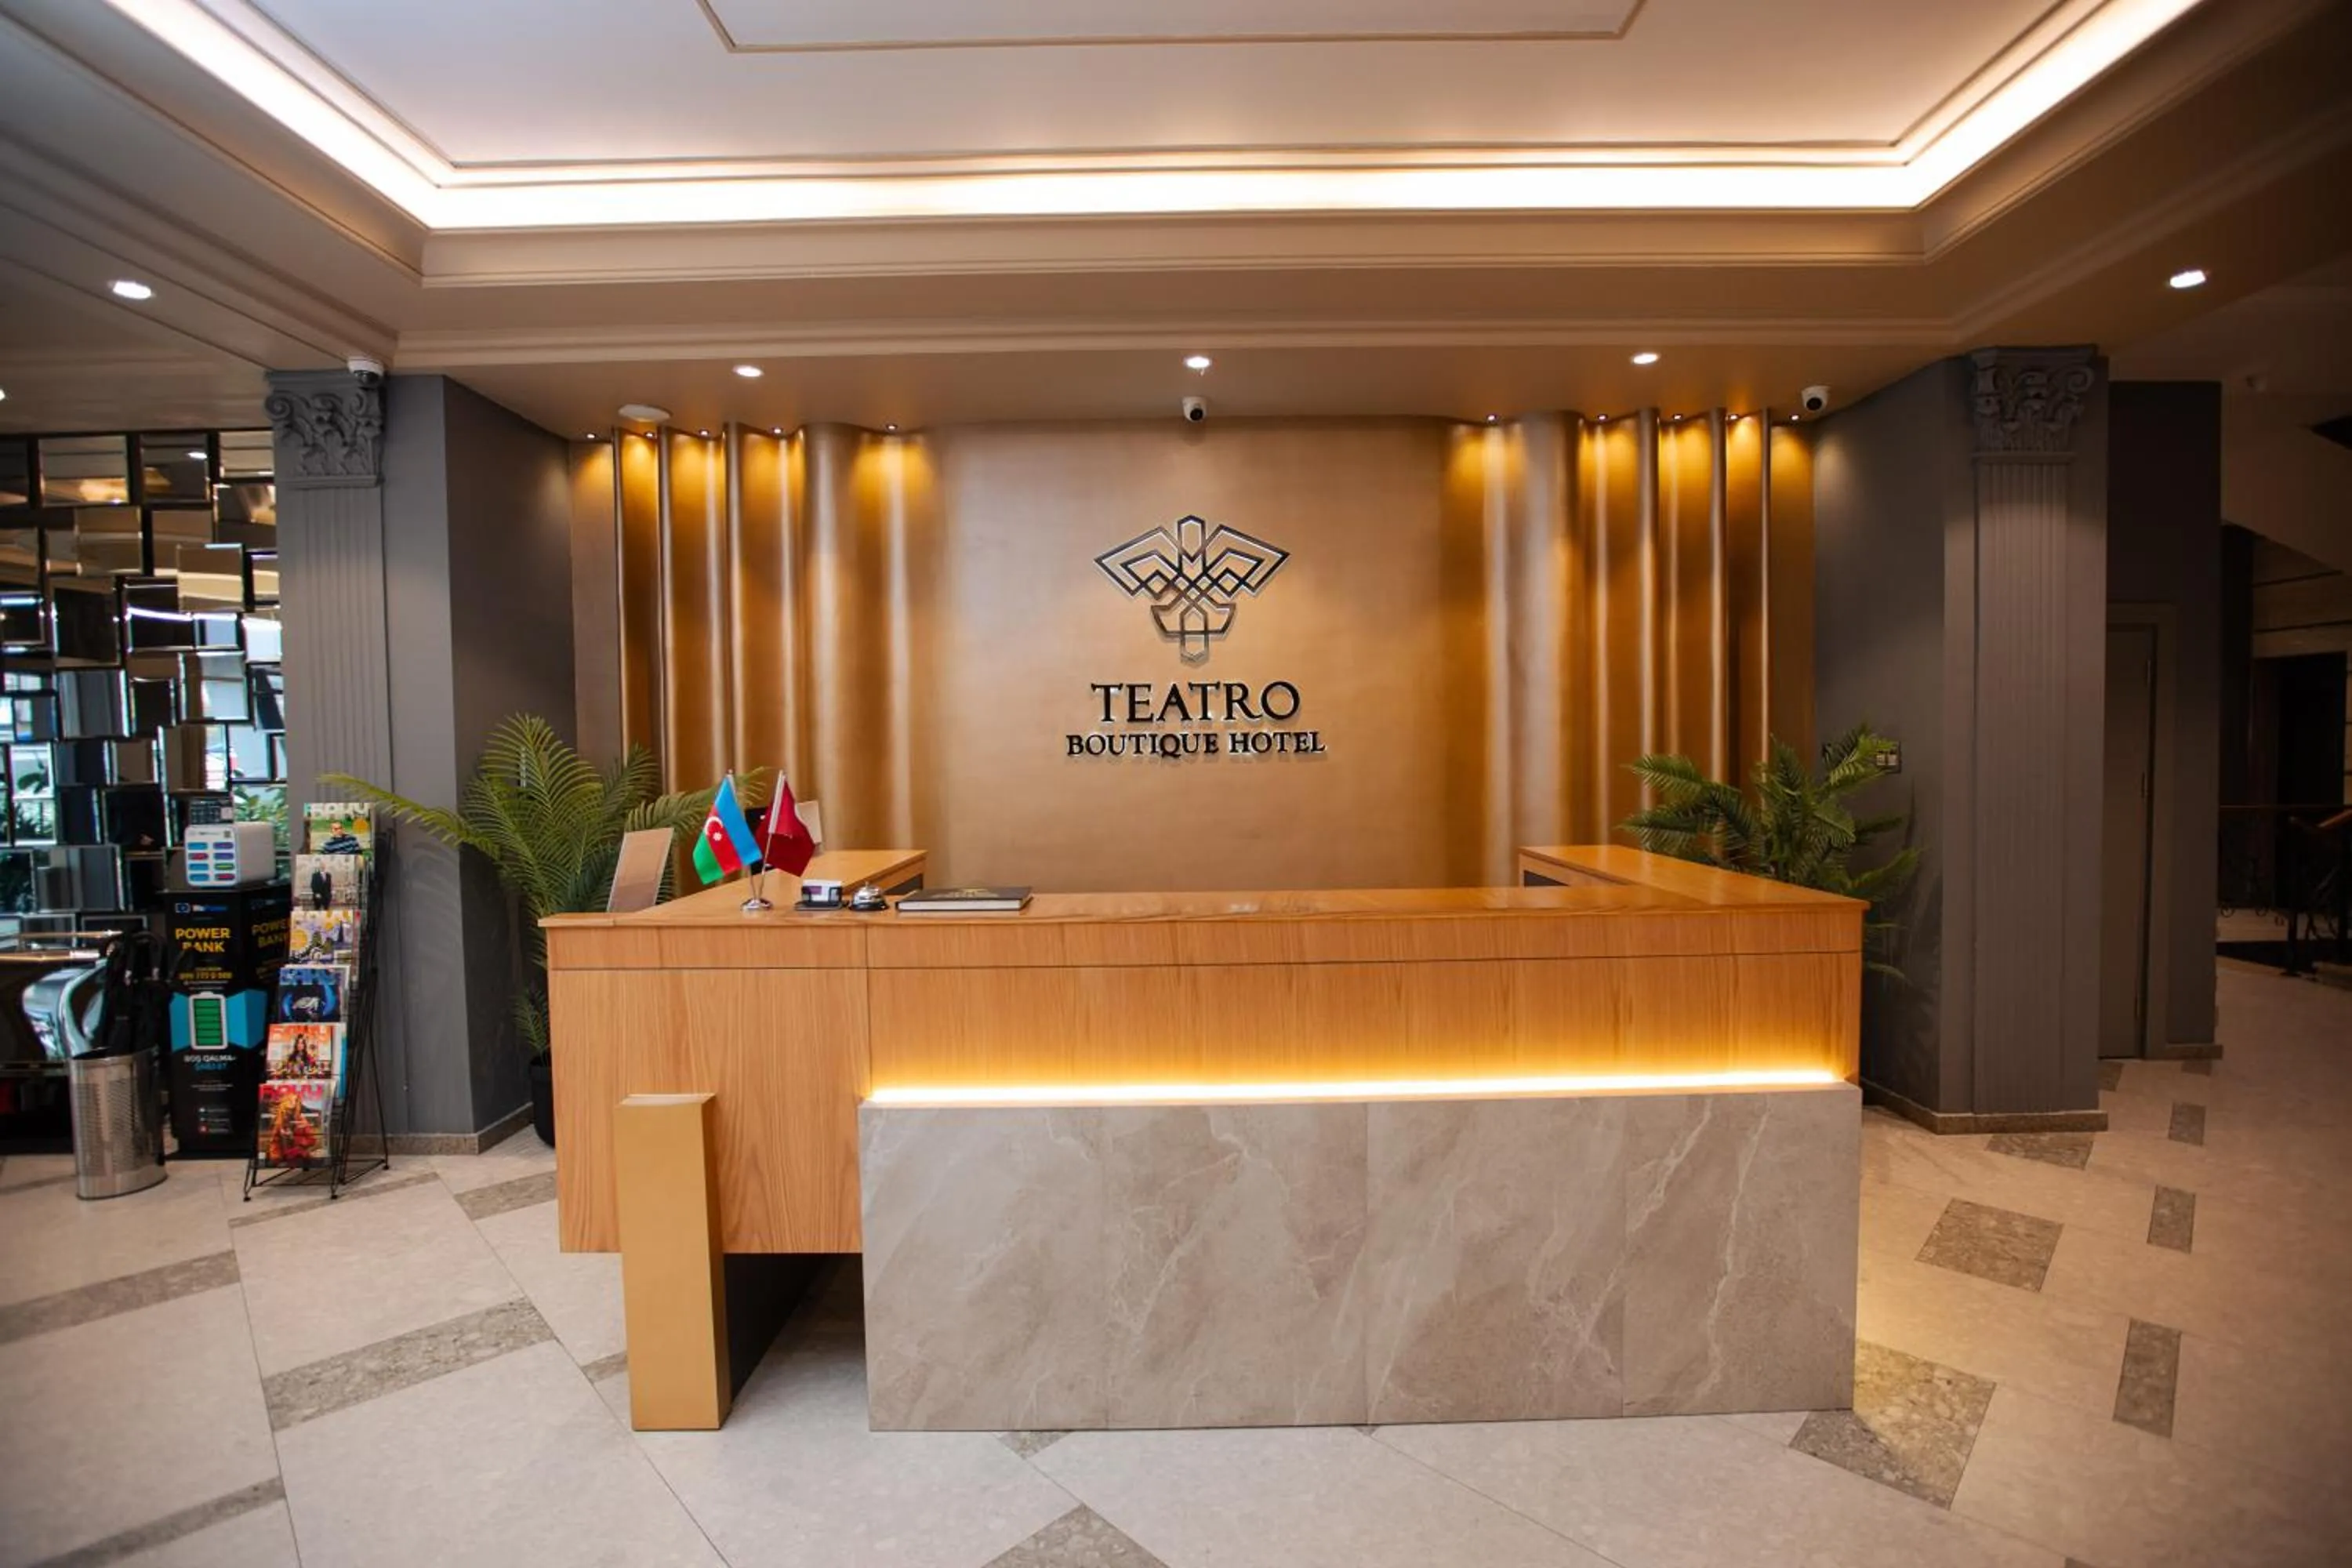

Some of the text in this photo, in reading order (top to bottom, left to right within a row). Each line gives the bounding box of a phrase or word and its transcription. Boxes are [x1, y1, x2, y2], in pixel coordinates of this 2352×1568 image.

[1091, 681, 1300, 722] TEATRO
[1066, 731, 1326, 757] BOUTIQUE HOTEL
[175, 928, 231, 939] POWER
